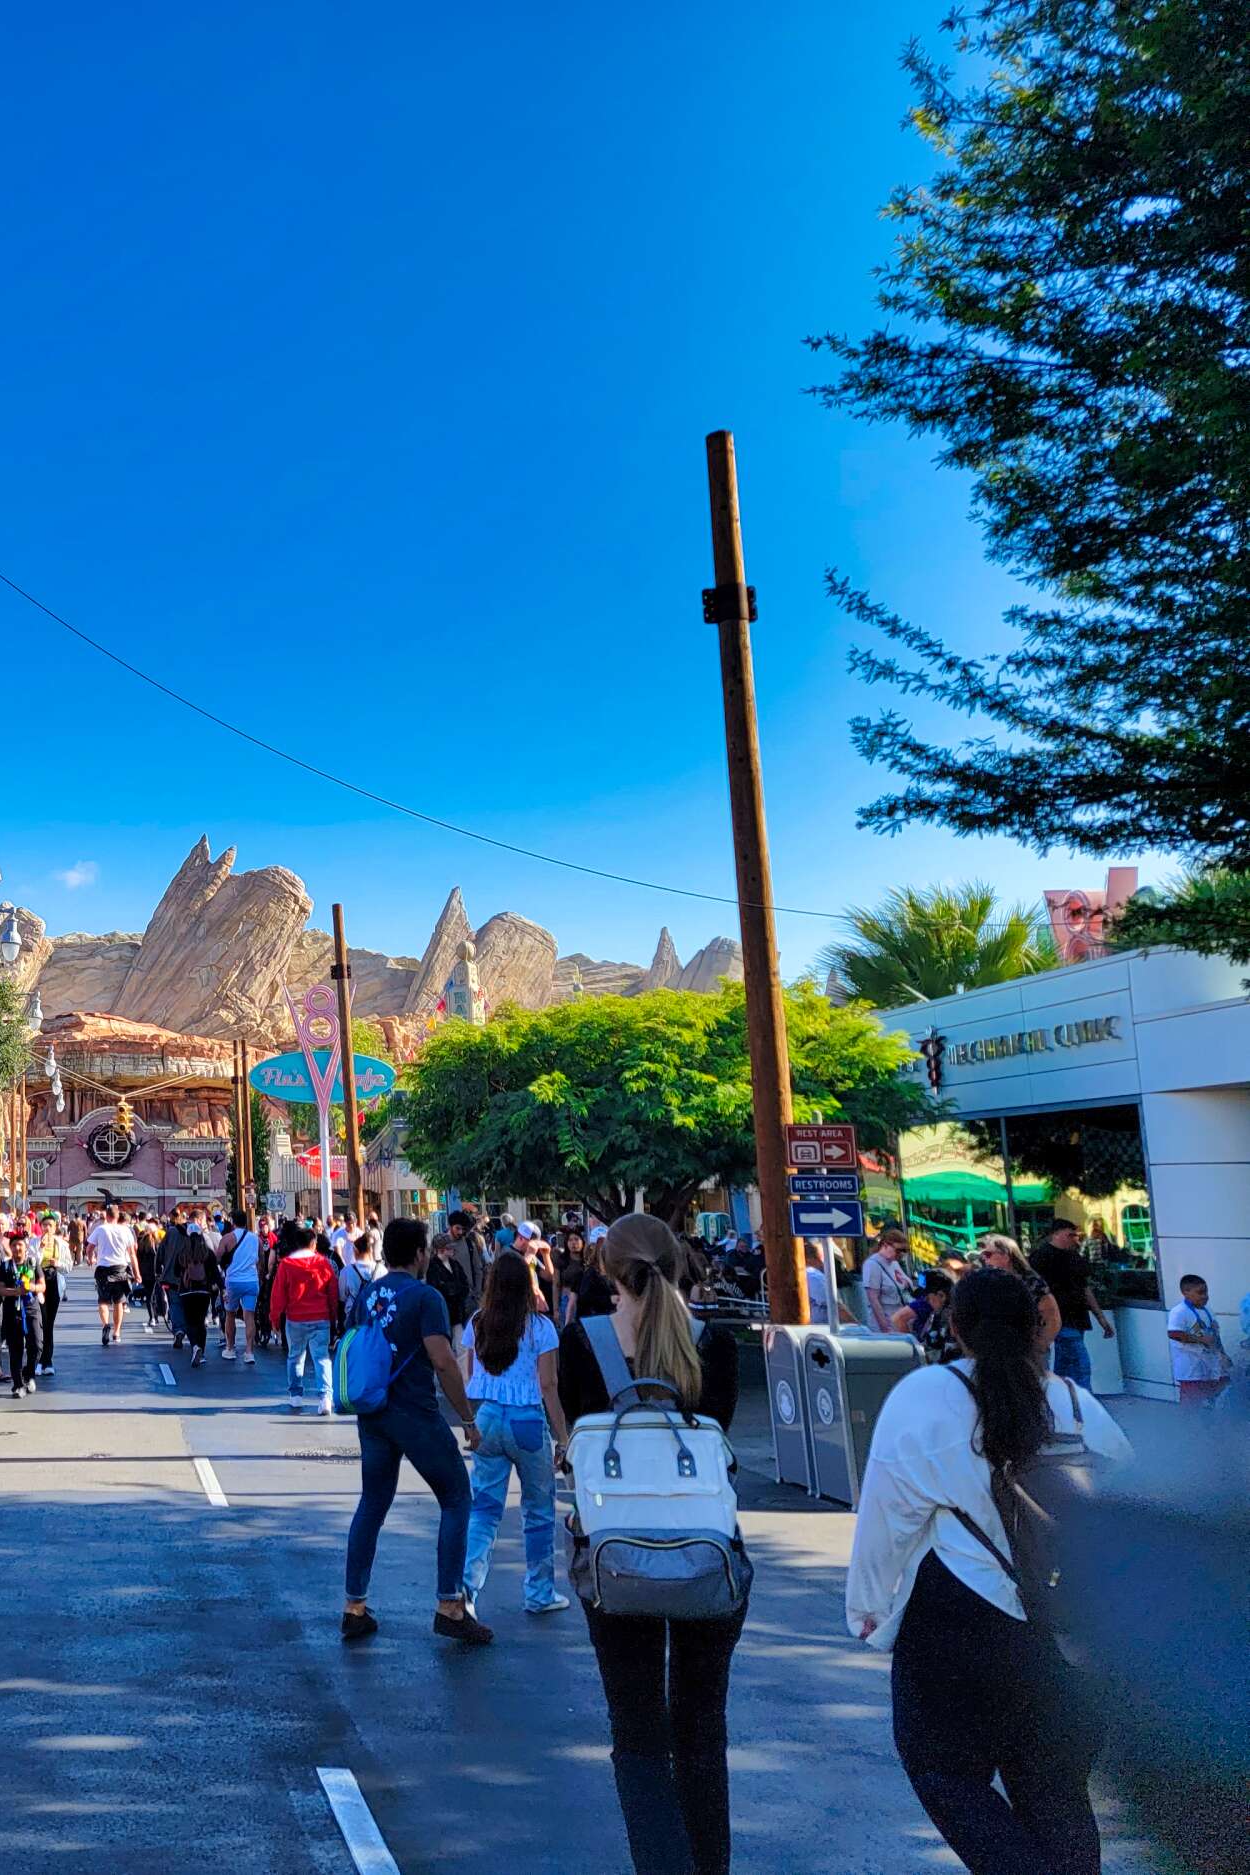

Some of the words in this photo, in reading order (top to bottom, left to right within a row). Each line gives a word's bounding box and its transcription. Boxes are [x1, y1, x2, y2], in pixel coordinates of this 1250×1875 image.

[796, 1130, 819, 1138] REST
[821, 1130, 843, 1138] AREA
[795, 1180, 853, 1191] RESTROOMS
